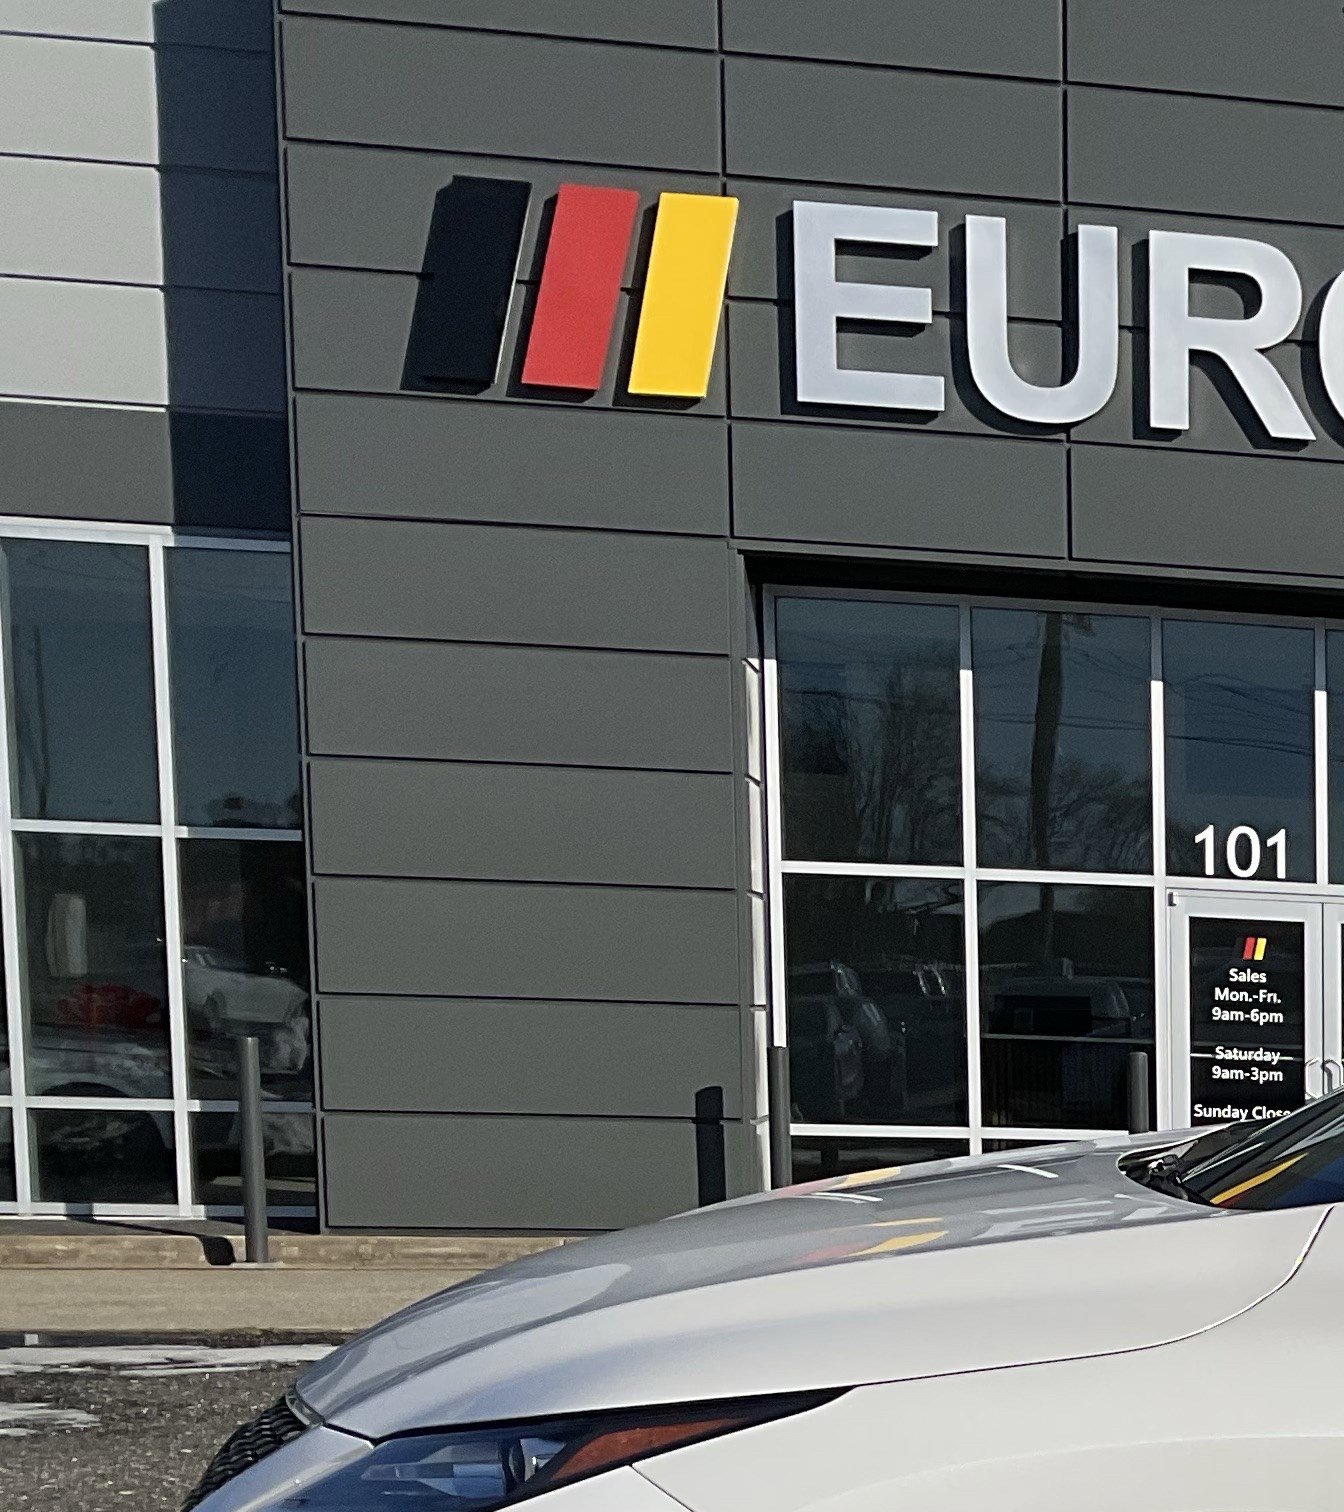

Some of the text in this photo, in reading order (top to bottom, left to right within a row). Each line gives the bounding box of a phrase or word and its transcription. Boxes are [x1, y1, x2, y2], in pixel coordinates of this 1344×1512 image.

[1194, 824, 1287, 879] 101
[1229, 967, 1267, 984] Sales
[1214, 986, 1282, 1004] Mon.-Fri.
[1211, 1006, 1284, 1026] 9am-6pm
[1215, 1046, 1281, 1065] Saturday
[1211, 1065, 1284, 1084] 9am-3pm
[1193, 1103, 1249, 1121] Sunday
